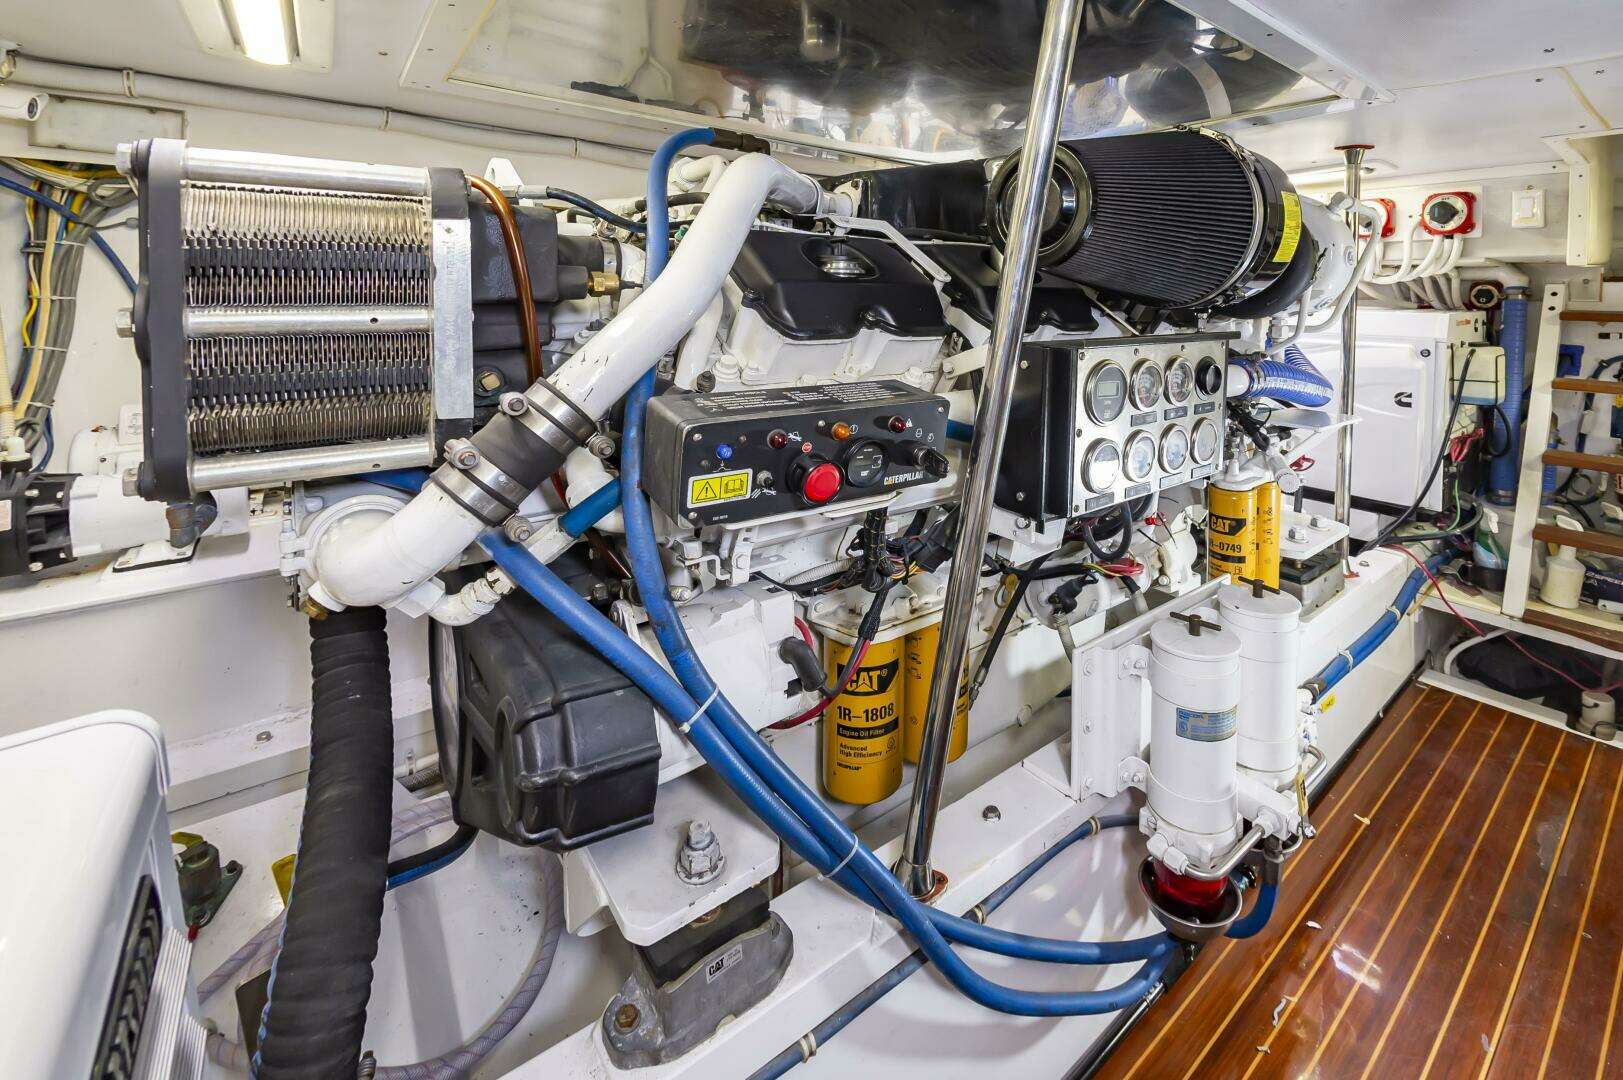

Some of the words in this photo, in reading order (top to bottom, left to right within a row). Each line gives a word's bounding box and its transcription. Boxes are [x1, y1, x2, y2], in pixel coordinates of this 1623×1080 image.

[884, 471, 923, 485] CATERPILLAR
[1211, 516, 1231, 533] CAT
[837, 703, 894, 722] 1R-1808
[839, 727, 858, 737] Engine
[870, 728, 885, 737] Filter
[839, 743, 868, 751] Advanced
[839, 750, 853, 758] High
[853, 751, 882, 759] Efficiency
[709, 957, 725, 976] CAT
